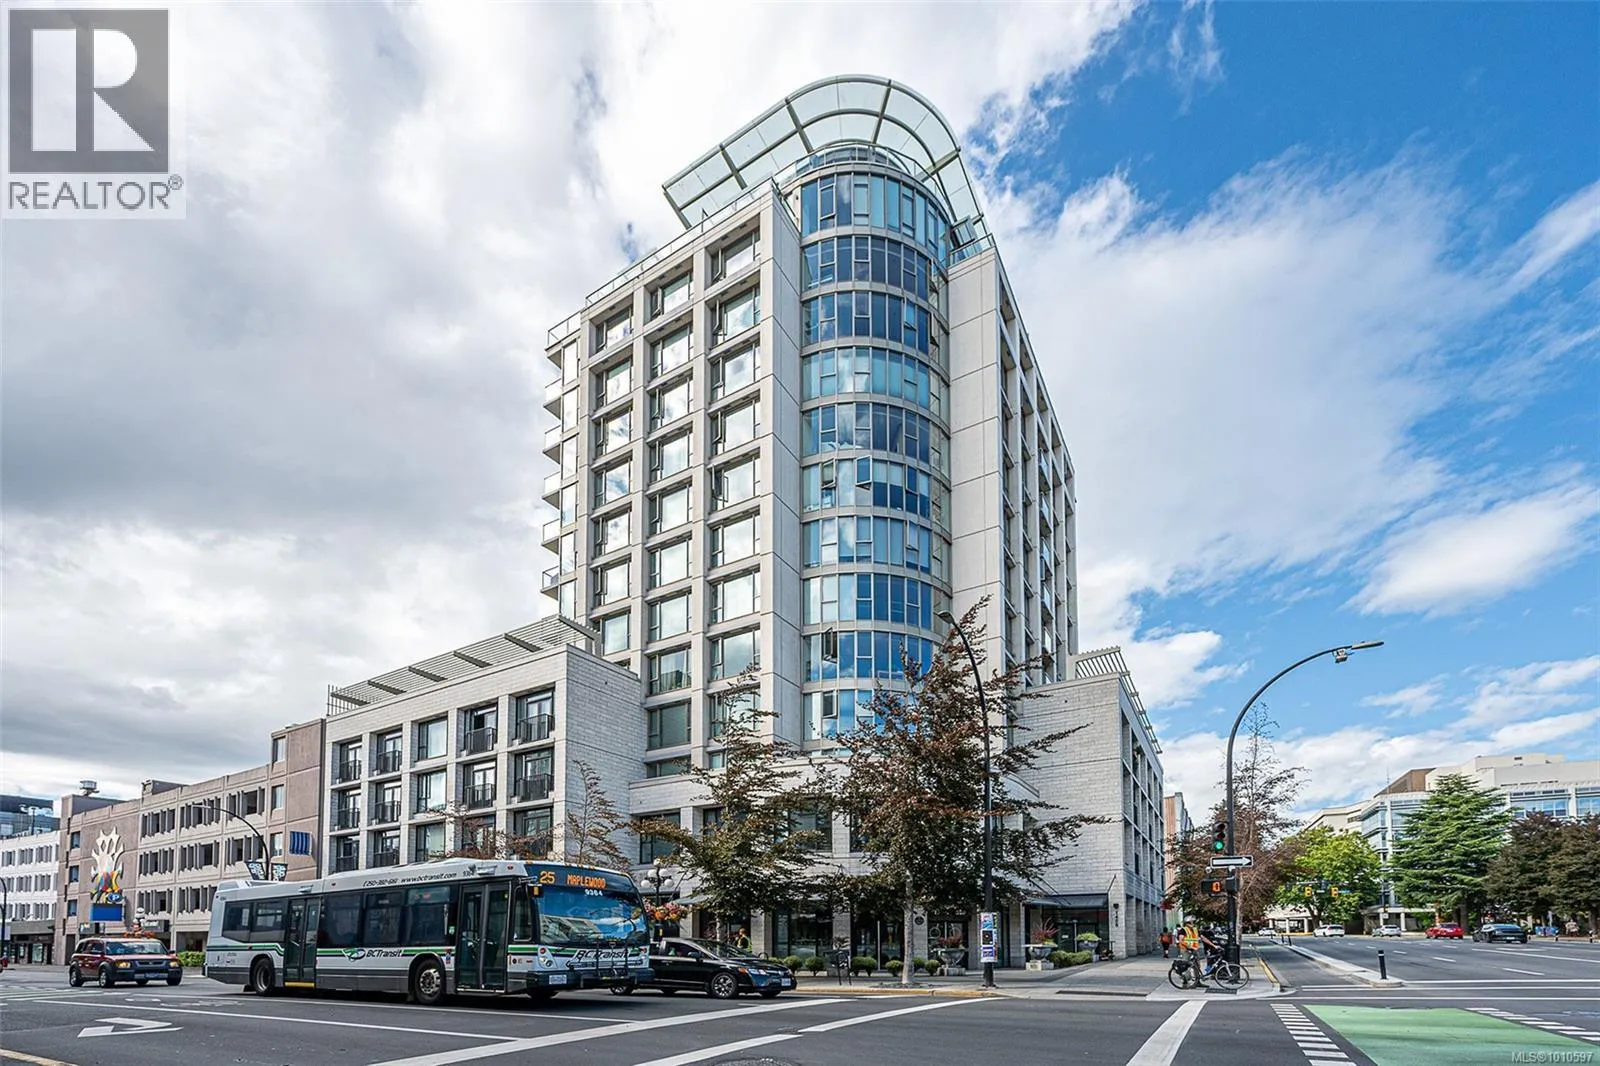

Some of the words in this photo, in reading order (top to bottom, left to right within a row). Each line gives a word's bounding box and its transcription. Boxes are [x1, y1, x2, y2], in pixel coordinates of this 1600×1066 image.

[540, 870, 556, 884] 25
[567, 873, 606, 888] MAPLEWOOD
[576, 949, 627, 959] BCTransi
